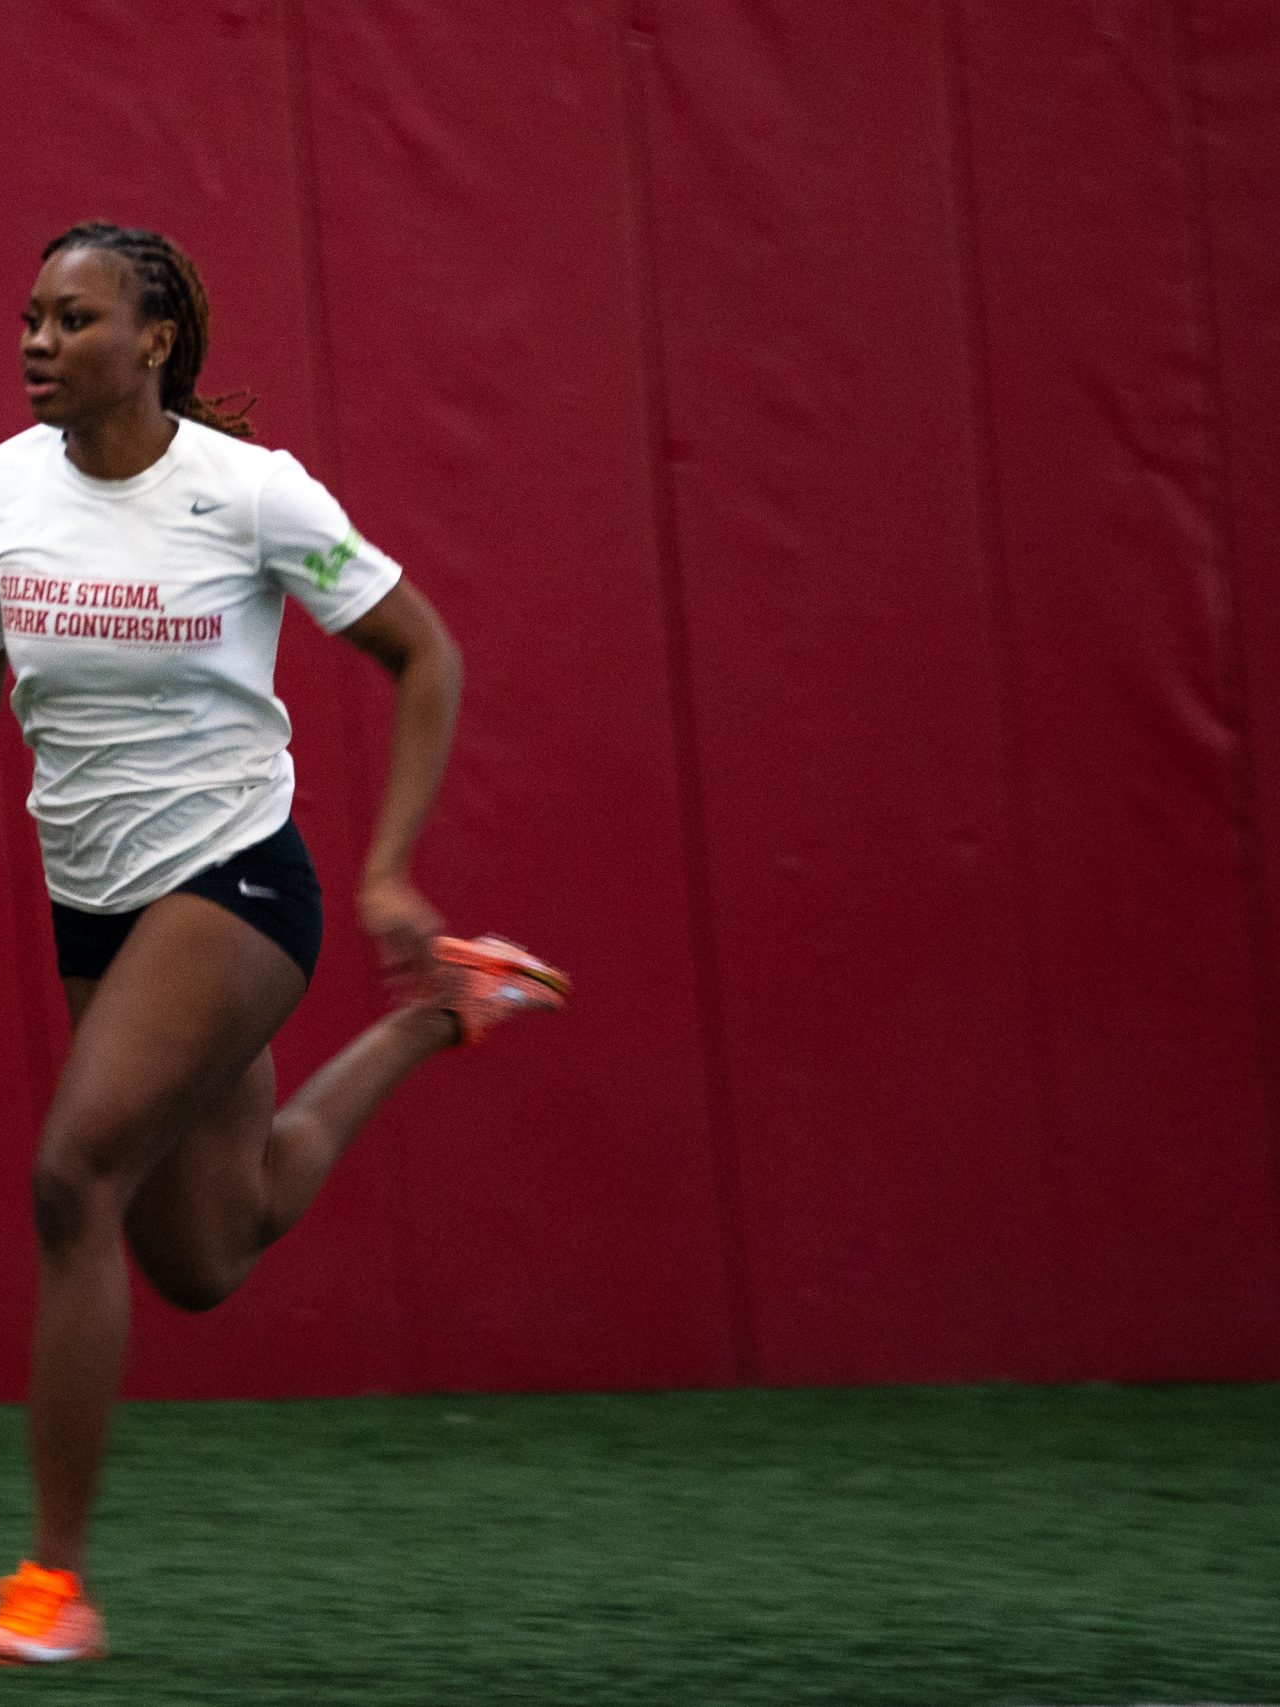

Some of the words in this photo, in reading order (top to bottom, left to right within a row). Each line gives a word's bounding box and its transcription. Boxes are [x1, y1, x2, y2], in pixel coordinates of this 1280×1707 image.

[0, 576, 70, 604] SILENCE
[76, 583, 164, 613] STIGMA,
[54, 612, 222, 643] CONVERSATION
